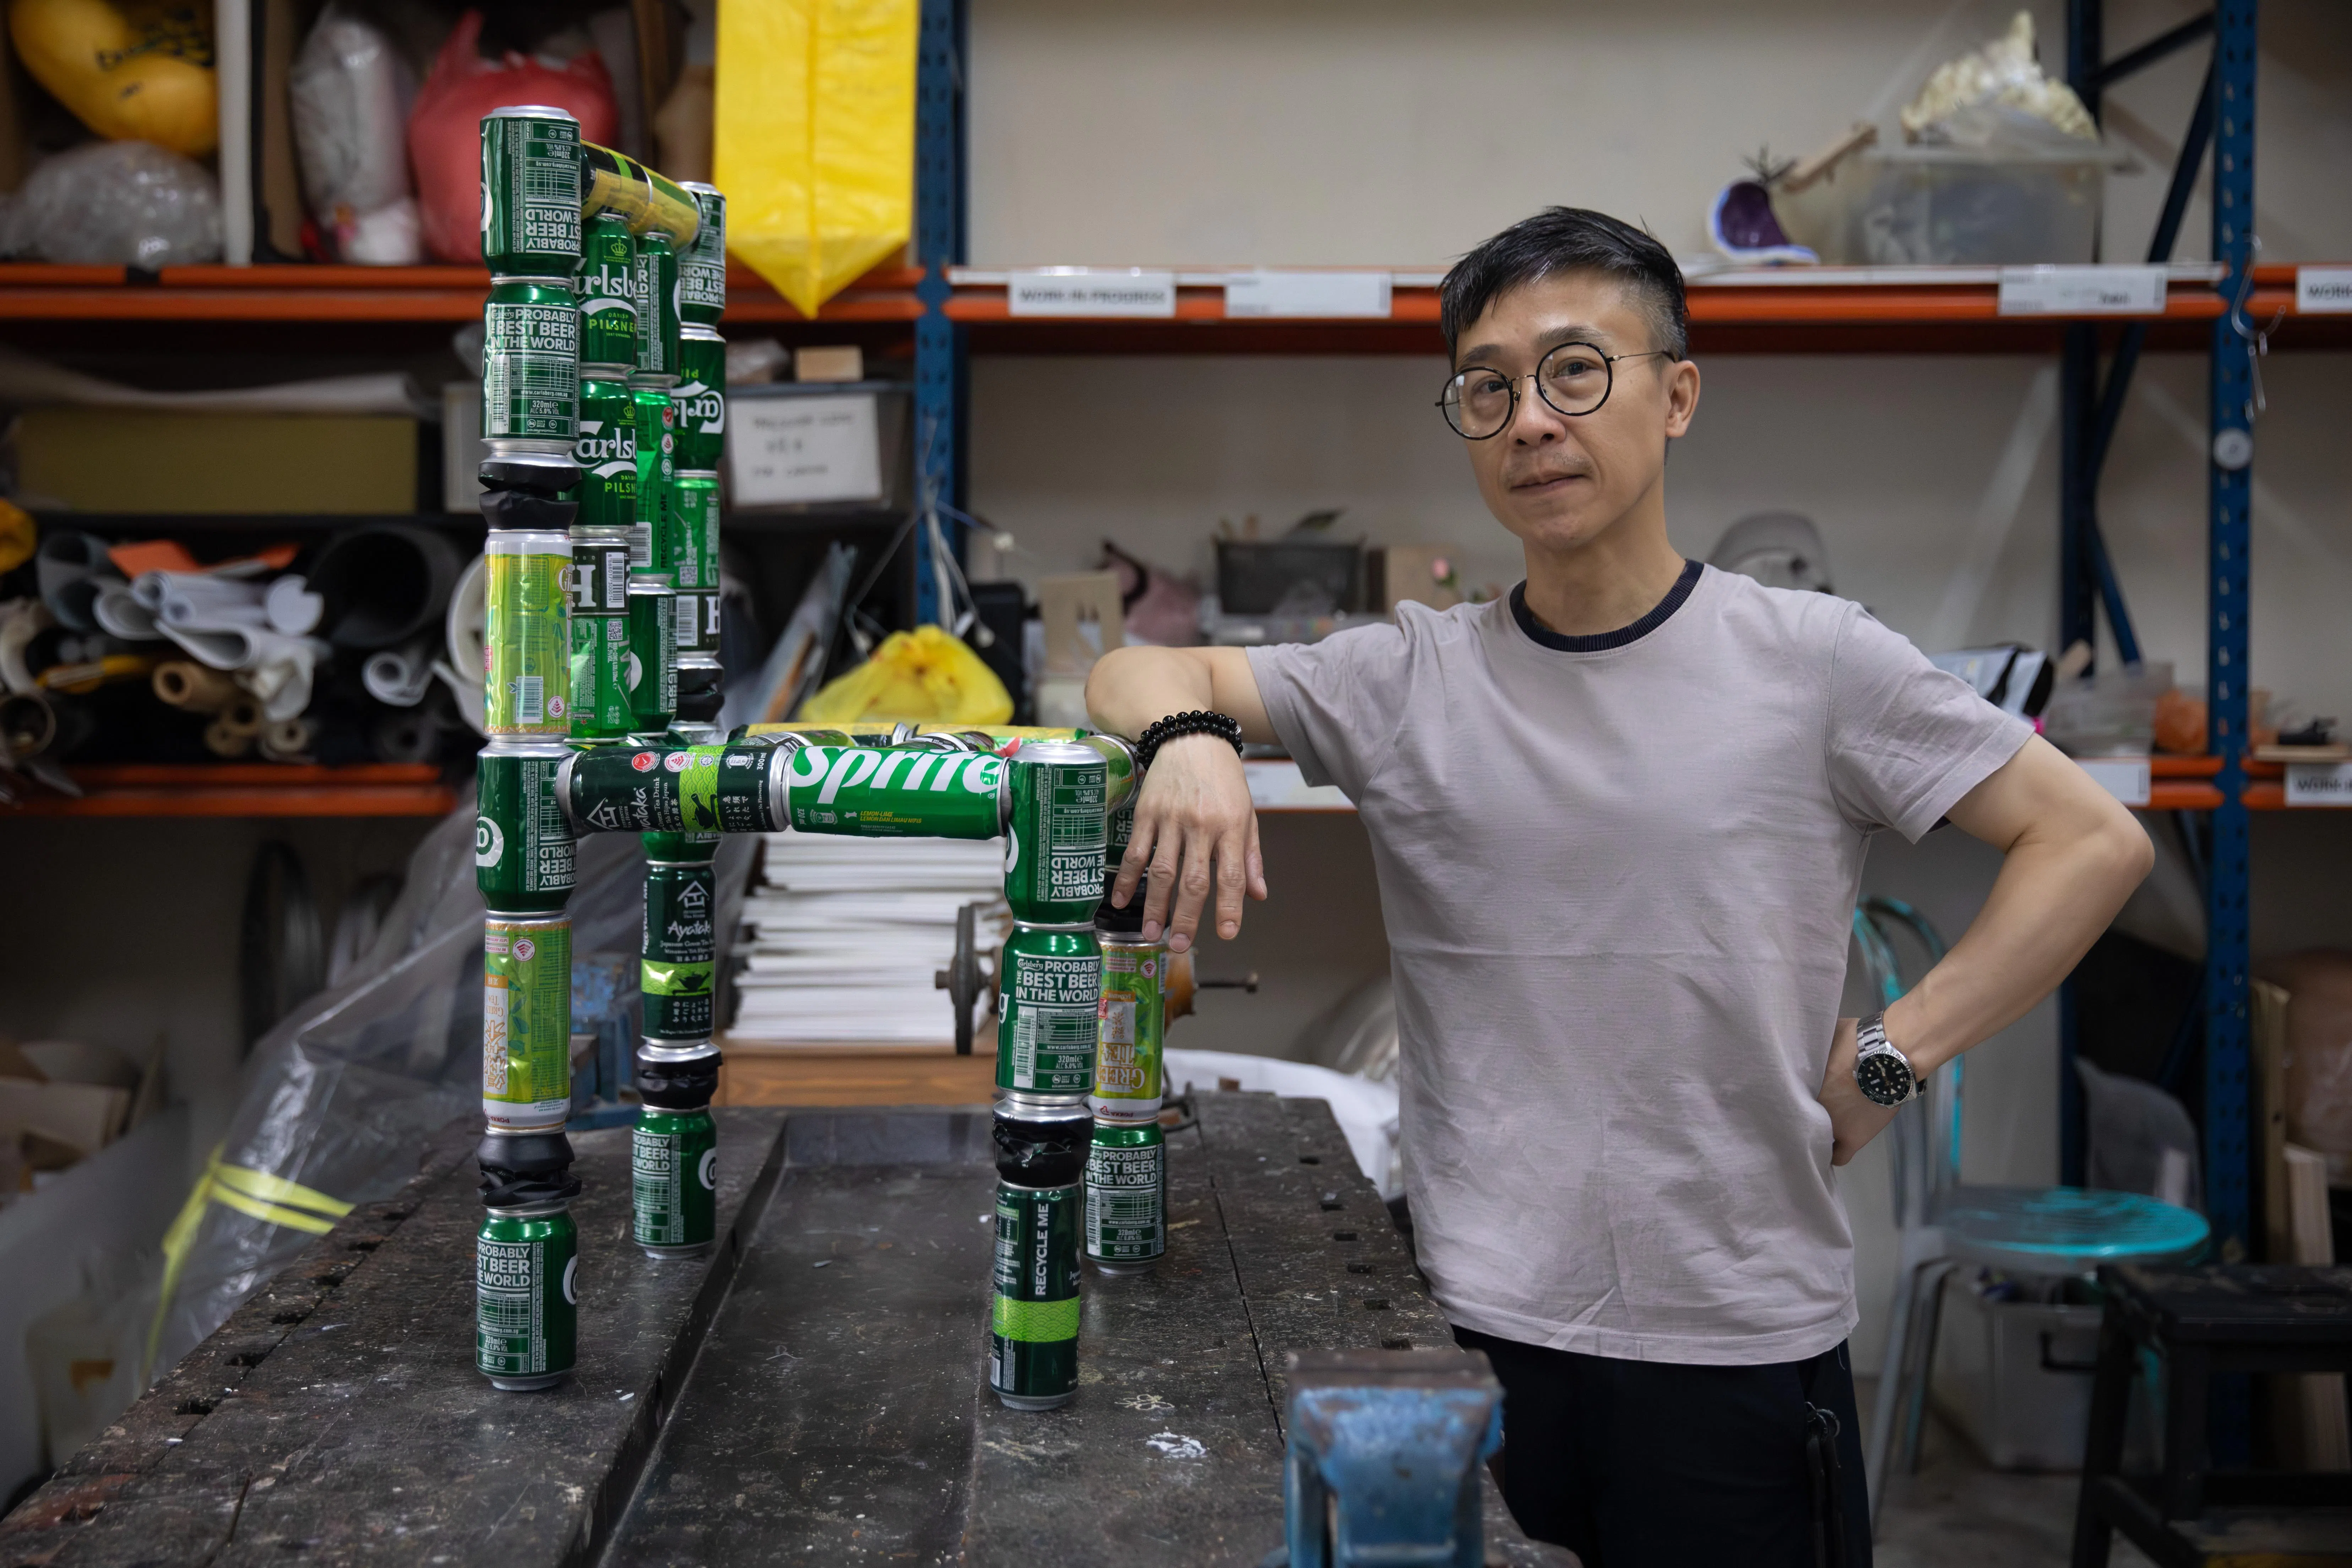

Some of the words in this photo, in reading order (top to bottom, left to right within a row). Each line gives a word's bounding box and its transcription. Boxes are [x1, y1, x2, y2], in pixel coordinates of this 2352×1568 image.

[525, 208, 572, 223] WORLD
[526, 222, 566, 237] BEER
[526, 237, 580, 251] PROBABLY
[515, 309, 576, 324] PROBABLY
[496, 321, 537, 335] BEST
[540, 322, 576, 339] BEER
[501, 336, 528, 348] THE
[530, 336, 576, 352] WORLD
[521, 390, 568, 398] www.carlsberg.com.sg
[790, 745, 1001, 804] Sprite
[630, 786, 658, 832] yataka
[539, 843, 576, 859] WORLD
[540, 858, 576, 873] BEER
[1051, 856, 1095, 869] WORLD
[1051, 869, 1089, 885] BEER
[1017, 958, 1043, 970] Carlsberg
[1044, 960, 1100, 972] PROBABLY
[1023, 972, 1066, 988] BEST
[1068, 972, 1098, 988] BEER
[1016, 986, 1027, 1000] IN
[1030, 987, 1057, 1001] THE
[1058, 987, 1098, 1002] WORLD
[640, 1147, 669, 1160] BEER
[1103, 1149, 1157, 1161] PROBABLY
[1089, 1159, 1120, 1174] BEST
[1122, 1160, 1156, 1174] BEER
[1093, 1172, 1114, 1184] THE
[1115, 1175, 1156, 1185] WORLD
[1037, 1203, 1049, 1228] ME
[490, 1258, 530, 1274] BEER
[1034, 1230, 1048, 1297] RECYCLE
[484, 1273, 530, 1287] WORLD
[485, 1335, 500, 1345] 320ml
